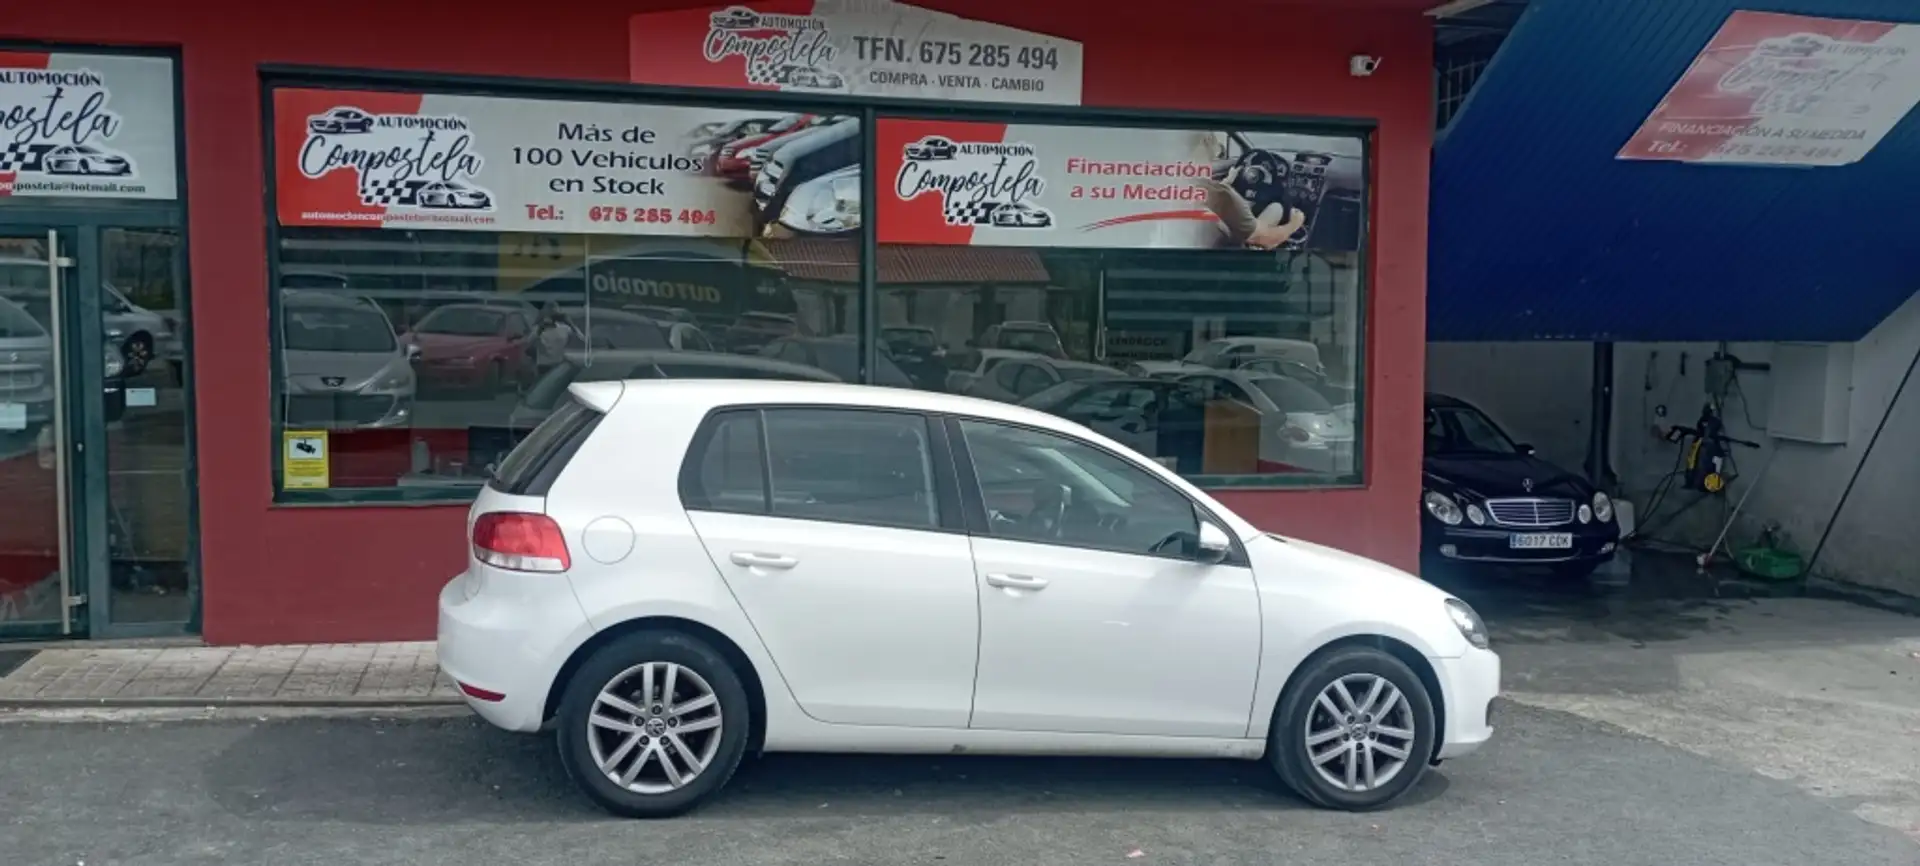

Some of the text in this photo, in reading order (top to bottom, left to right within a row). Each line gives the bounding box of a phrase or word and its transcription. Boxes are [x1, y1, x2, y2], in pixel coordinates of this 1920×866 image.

[761, 16, 825, 30] AUTOMOCIÓN
[706, 28, 836, 71] Compostela
[853, 36, 1058, 70] TFN. 675 285 494
[869, 71, 1044, 92] COMPRA VENTA CAMBIO
[0, 86, 119, 145] ostela
[377, 116, 467, 130] AUTOMOCIÓN
[557, 122, 656, 144] Más de
[301, 130, 482, 187] Compostela
[512, 147, 562, 166] 100
[959, 144, 1034, 157] AUTOMOCIÓN
[1066, 157, 1212, 178] Financiación
[549, 176, 664, 196] en Stock
[897, 156, 1044, 209] Compostela
[1069, 183, 1208, 201] a su Medida
[589, 206, 627, 223] 675
[634, 208, 672, 225] 285
